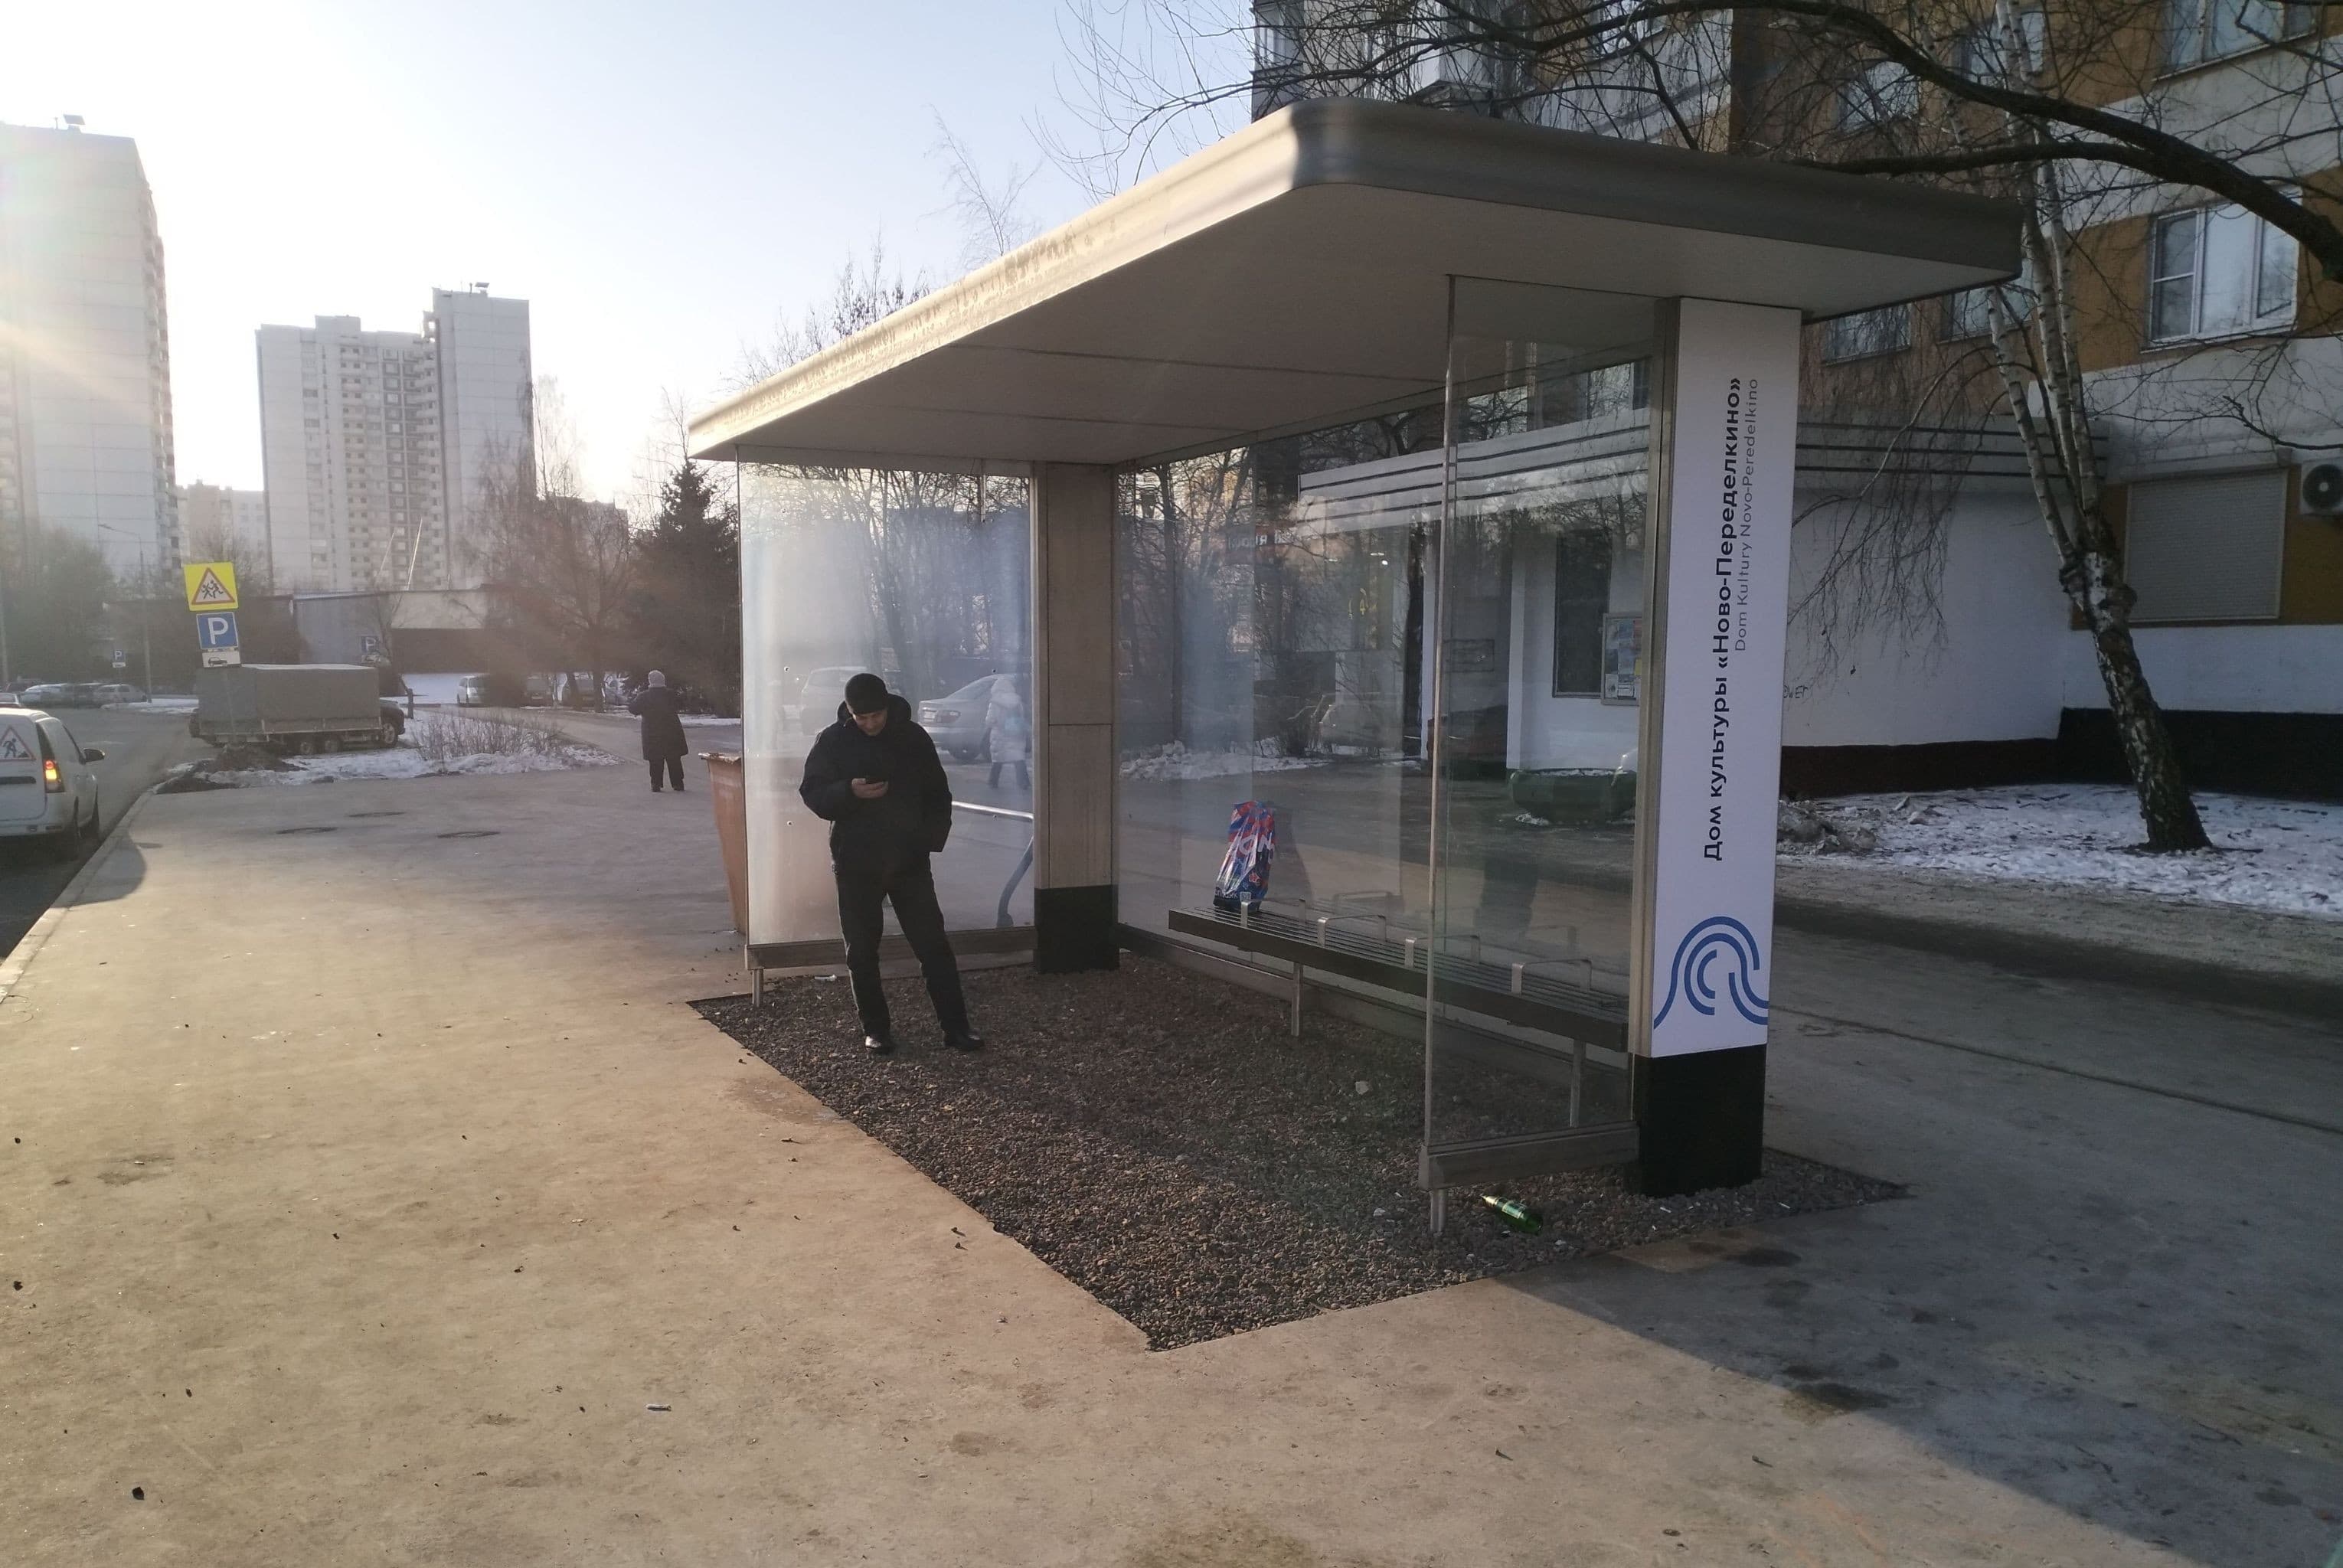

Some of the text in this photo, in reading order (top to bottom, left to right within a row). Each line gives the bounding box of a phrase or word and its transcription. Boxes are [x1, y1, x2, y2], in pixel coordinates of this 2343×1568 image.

[208, 617, 229, 645] P
[1703, 377, 1740, 861] Дом культуры «Ново-Переделкино»
[1734, 378, 1758, 651] Dom Kultury Novo-Peredelkino
